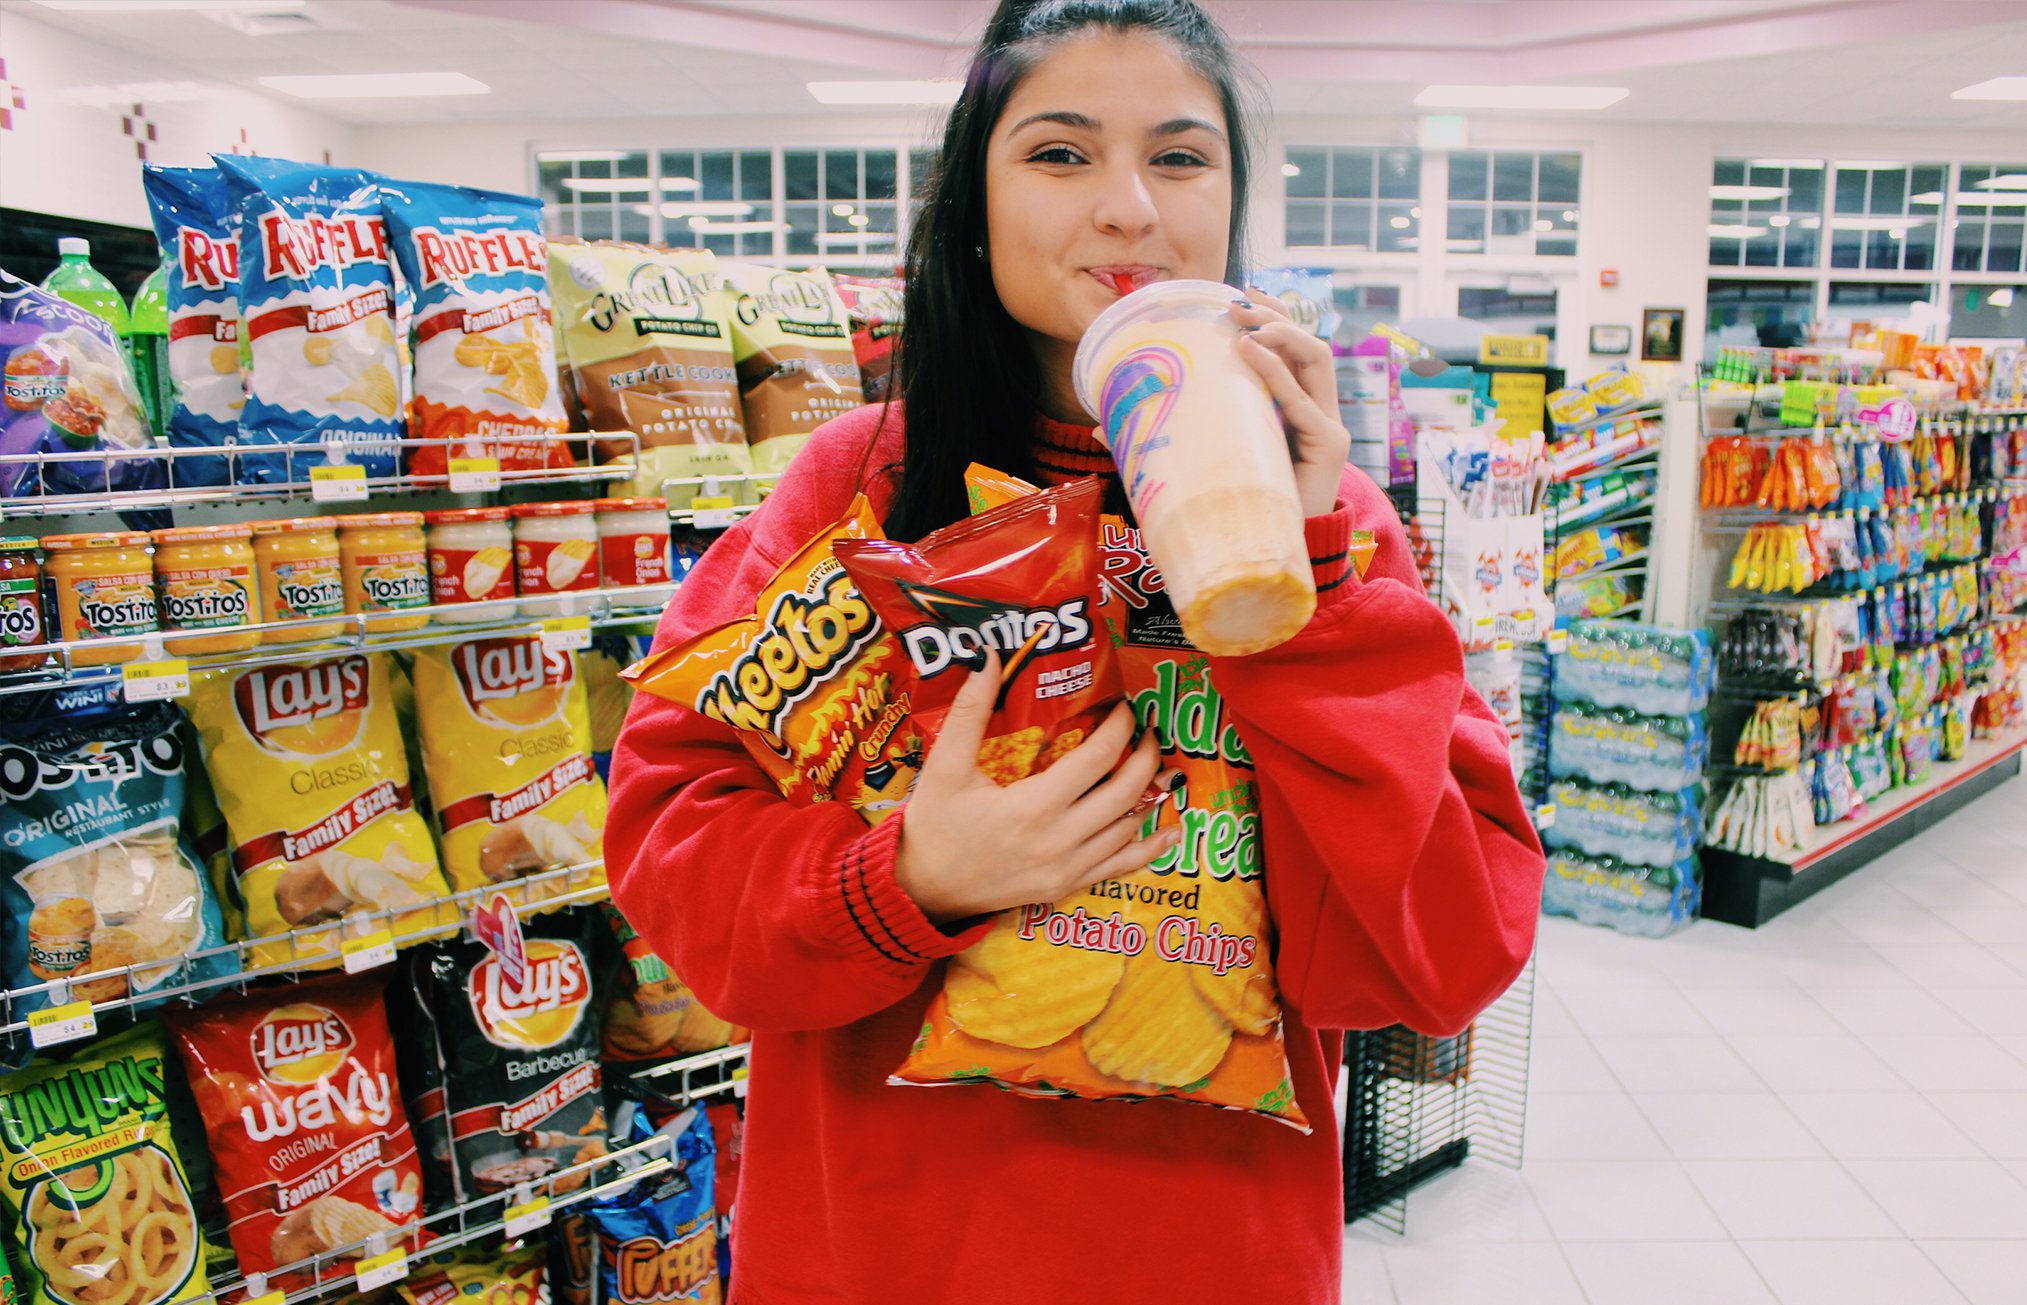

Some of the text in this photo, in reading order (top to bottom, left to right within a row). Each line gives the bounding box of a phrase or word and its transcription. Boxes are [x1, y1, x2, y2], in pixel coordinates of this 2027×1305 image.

[264, 214, 389, 276] RUFFLE
[307, 289, 388, 332] Family Size!
[463, 307, 509, 334] Family
[609, 364, 738, 389] KETTLE COOK
[642, 419, 709, 434] POTATO
[820, 561, 841, 576] CHEE
[0, 607, 36, 635] TOS
[86, 597, 156, 625] TOSTITO
[700, 575, 876, 740] heetos
[903, 599, 1091, 678] Doritos
[250, 657, 365, 733] Lay's
[463, 640, 567, 702] Lays
[1034, 674, 1093, 700] CHEESE
[500, 728, 575, 759] Classic
[858, 691, 911, 762] Crunchy
[0, 723, 184, 801] OSTITO
[290, 758, 378, 796] Classic
[490, 757, 590, 823] Family Size!
[4, 791, 128, 848] ORIGINAL
[64, 797, 171, 840] RESTAURANT STYLE
[283, 781, 399, 861] Family Size!
[1017, 903, 1258, 976] Potato Chips
[263, 1016, 343, 1069] Lay's
[506, 1047, 588, 1081] Barbecue
[0, 1056, 167, 1147] UNYUNS
[501, 1066, 595, 1132] Family Size!
[18, 1155, 59, 1178] Onion
[61, 1137, 120, 1162] Flavored
[269, 1131, 338, 1172] ORIGINAL
[278, 1138, 382, 1211] Family Size!
